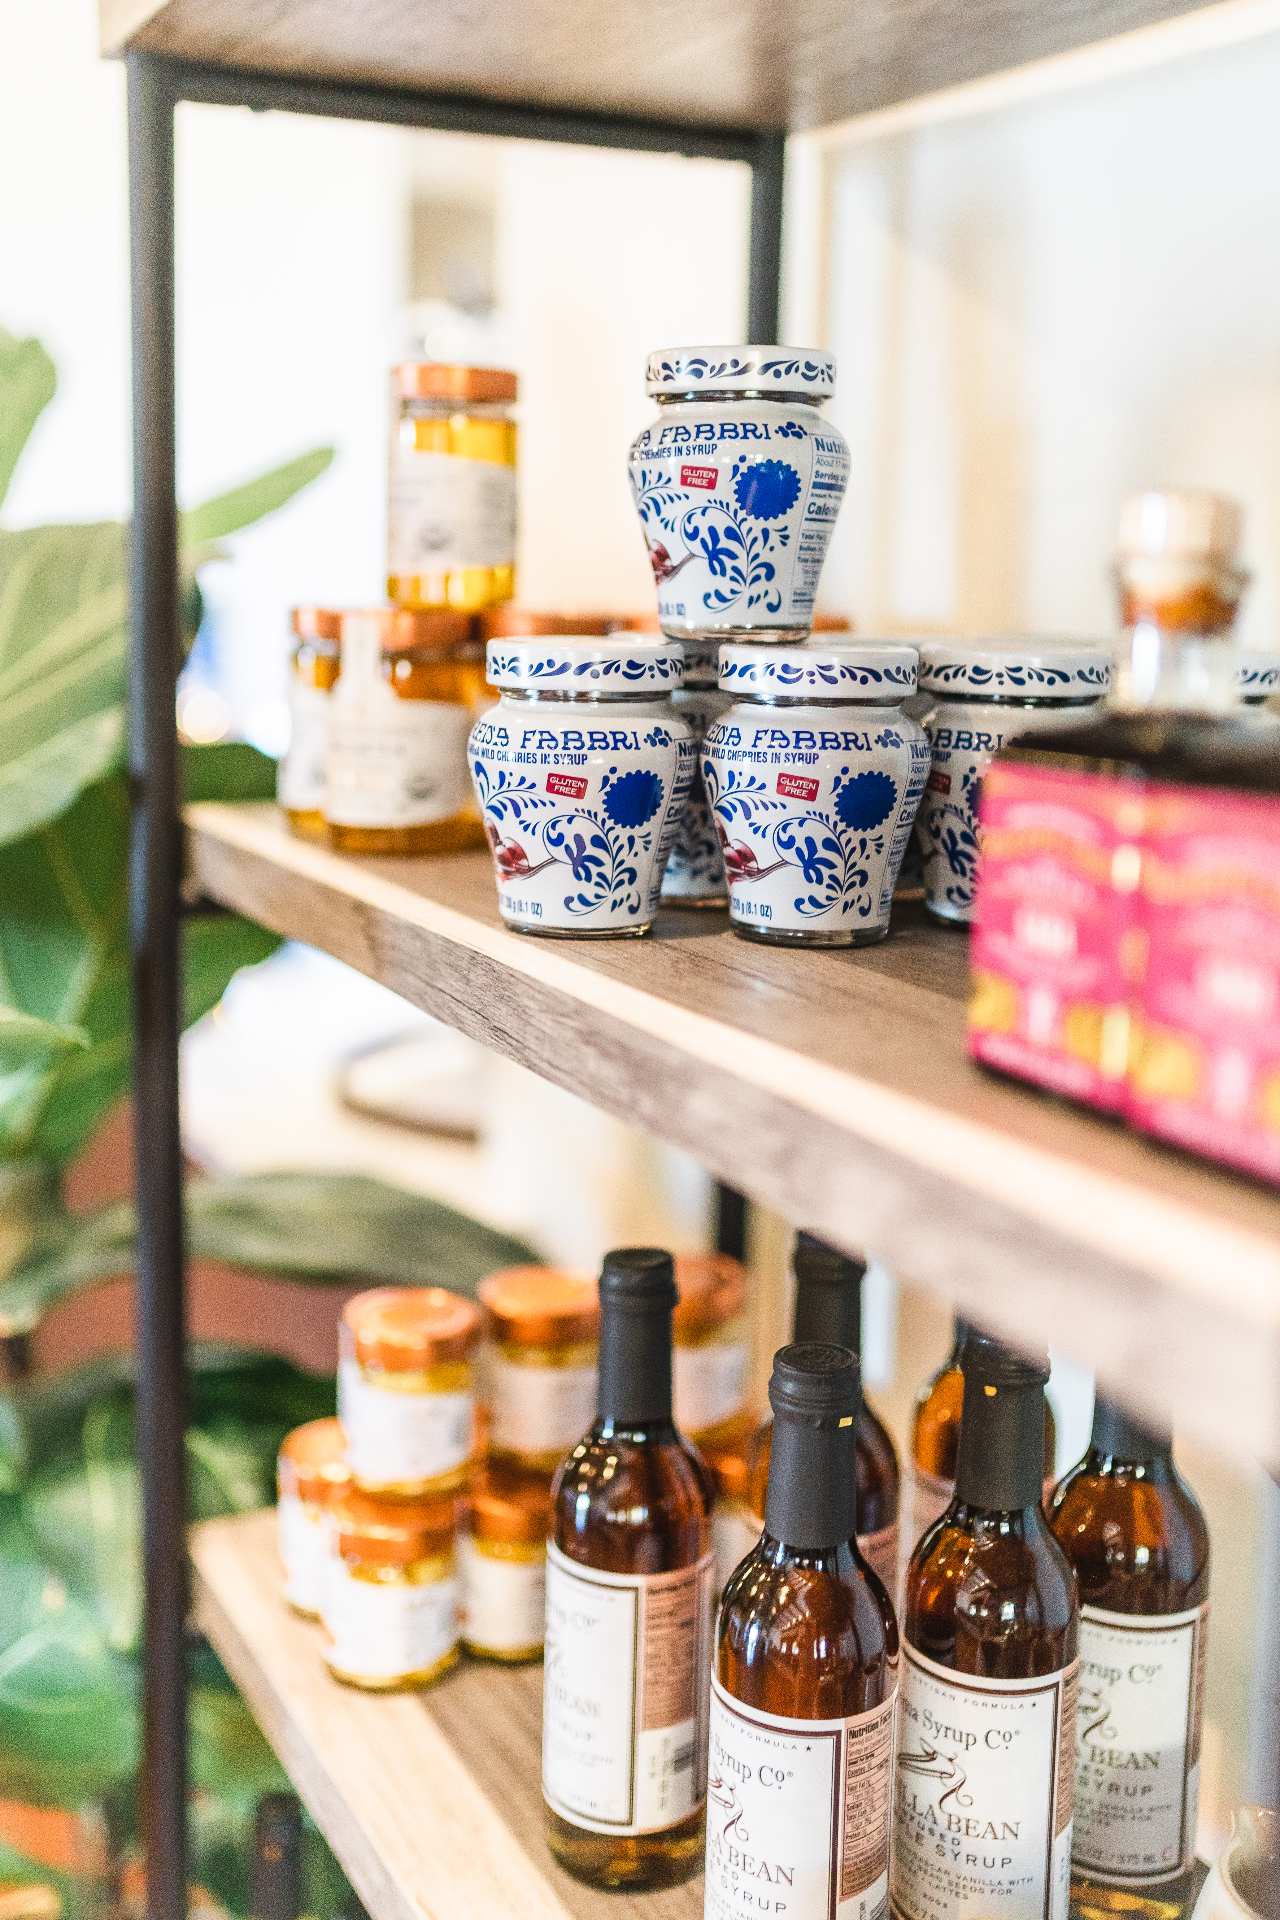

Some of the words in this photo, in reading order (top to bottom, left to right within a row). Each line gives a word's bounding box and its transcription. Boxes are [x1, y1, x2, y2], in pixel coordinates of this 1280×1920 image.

[658, 422, 772, 444] FABBRI
[674, 445, 683, 457] IN
[685, 443, 718, 457] SYRUP
[682, 468, 716, 478] GLUTEN
[687, 477, 709, 486] FREE
[520, 729, 641, 752] FABBRI
[751, 729, 872, 752] FABBRI
[924, 727, 1003, 752] BBRI
[540, 752, 551, 765] IN
[553, 753, 588, 766] SYRUP
[770, 752, 781, 764] IN
[783, 752, 820, 766] SYRUP
[549, 775, 585, 789] GLUTEN
[553, 785, 578, 796] FREE
[779, 776, 817, 790] GLUTEN
[785, 787, 809, 798] FREE
[760, 903, 773, 921] OZ)
[963, 1697, 1026, 1711] FORMULA
[739, 1727, 798, 1751] FORMULA
[922, 1708, 978, 1752] Syrup
[714, 1732, 752, 1784] Syrup
[946, 1812, 1022, 1841] BEAN
[728, 1844, 796, 1887] BEAN
[935, 1843, 1013, 1870] SYRUP
[720, 1875, 787, 1914] SYRUP
